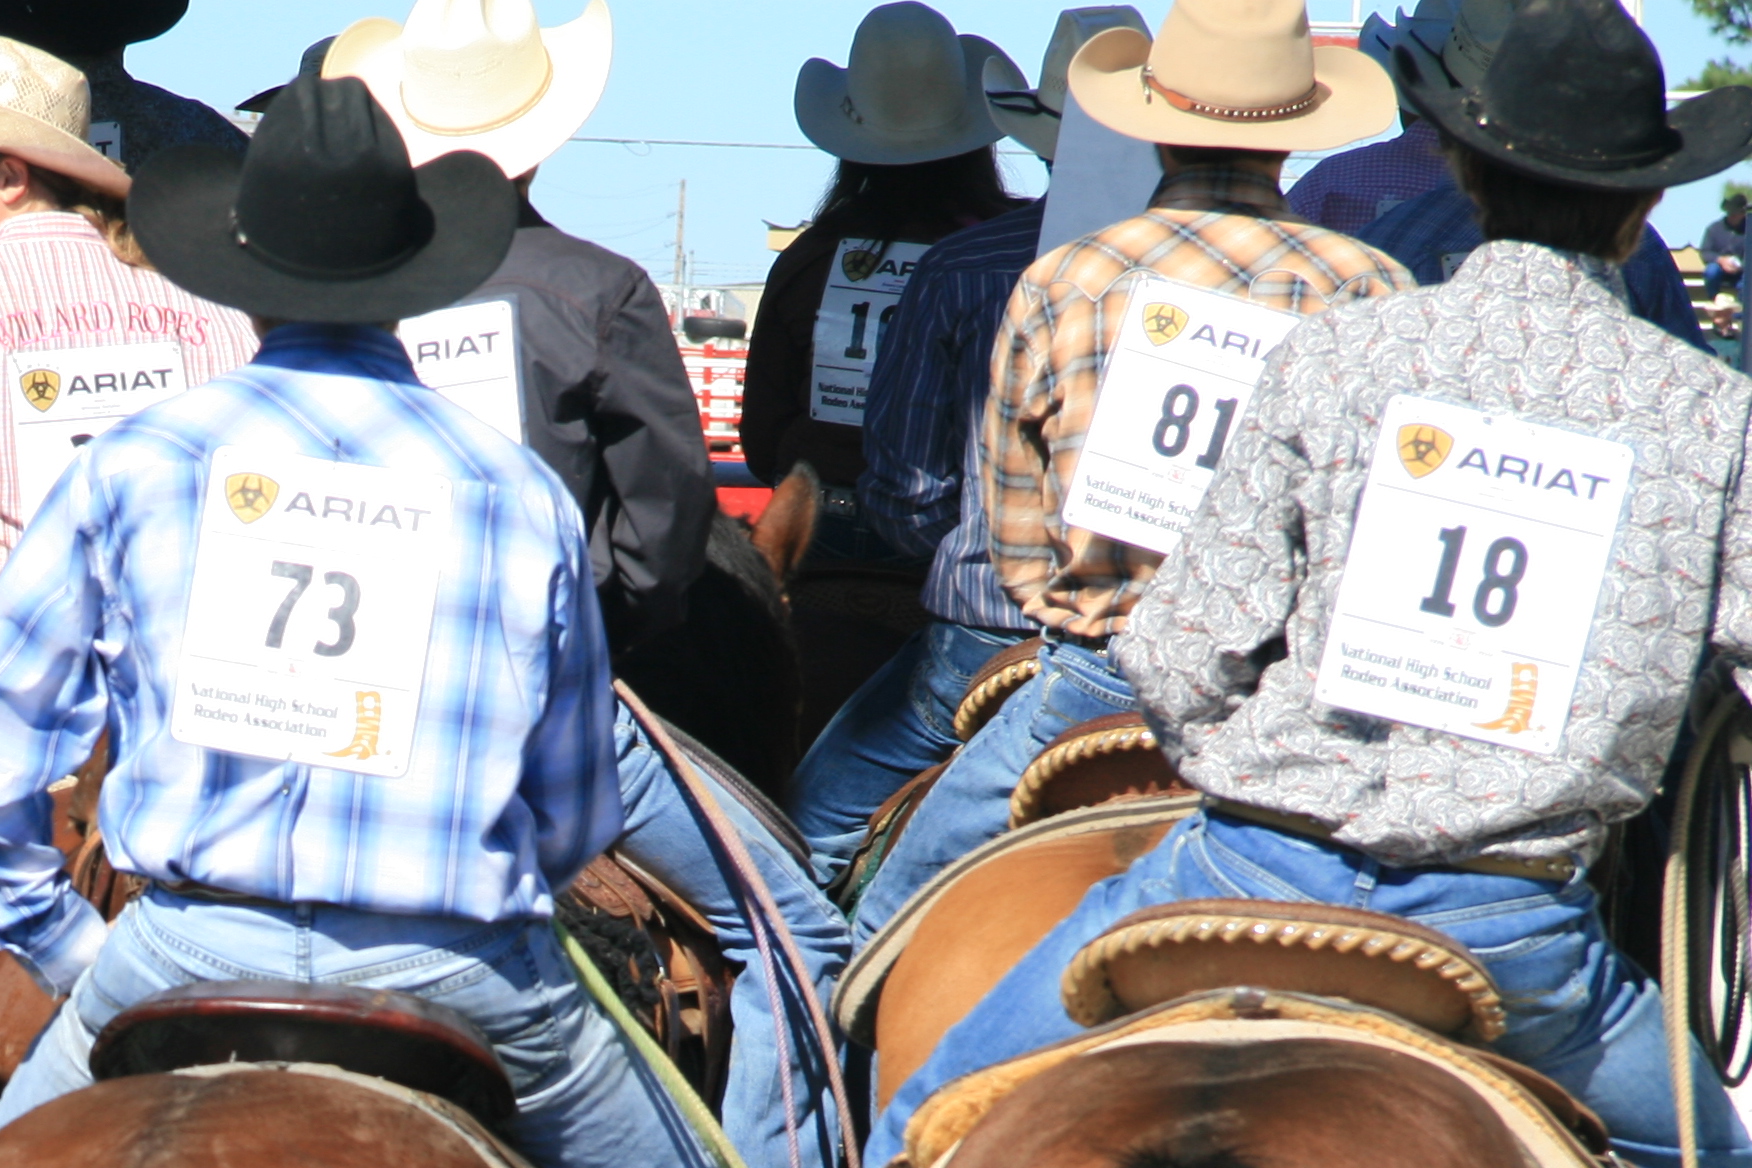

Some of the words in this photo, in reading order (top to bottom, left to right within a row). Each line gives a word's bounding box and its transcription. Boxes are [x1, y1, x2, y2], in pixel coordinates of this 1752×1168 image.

[128, 301, 208, 346] ROPES
[1190, 324, 1272, 361] ARI
[417, 331, 500, 364] RIAT
[67, 368, 173, 396] ARIAT
[1152, 383, 1239, 470] 81
[1456, 447, 1611, 500] ARIAT
[284, 491, 432, 532] ARIAT
[1084, 492, 1123, 515] Rodeo
[1124, 505, 1188, 534] Associati
[1086, 474, 1137, 500] National
[1137, 490, 1166, 510] High
[1167, 500, 1197, 519] Scho
[1419, 525, 1529, 628] 18
[264, 560, 362, 658] 73
[1340, 663, 1387, 688] Rodeo
[1389, 677, 1479, 709] Association
[1341, 641, 1403, 669] National
[1405, 657, 1439, 679] High
[1442, 666, 1493, 690] School
[194, 703, 239, 724] Rodeo
[254, 693, 287, 713] High
